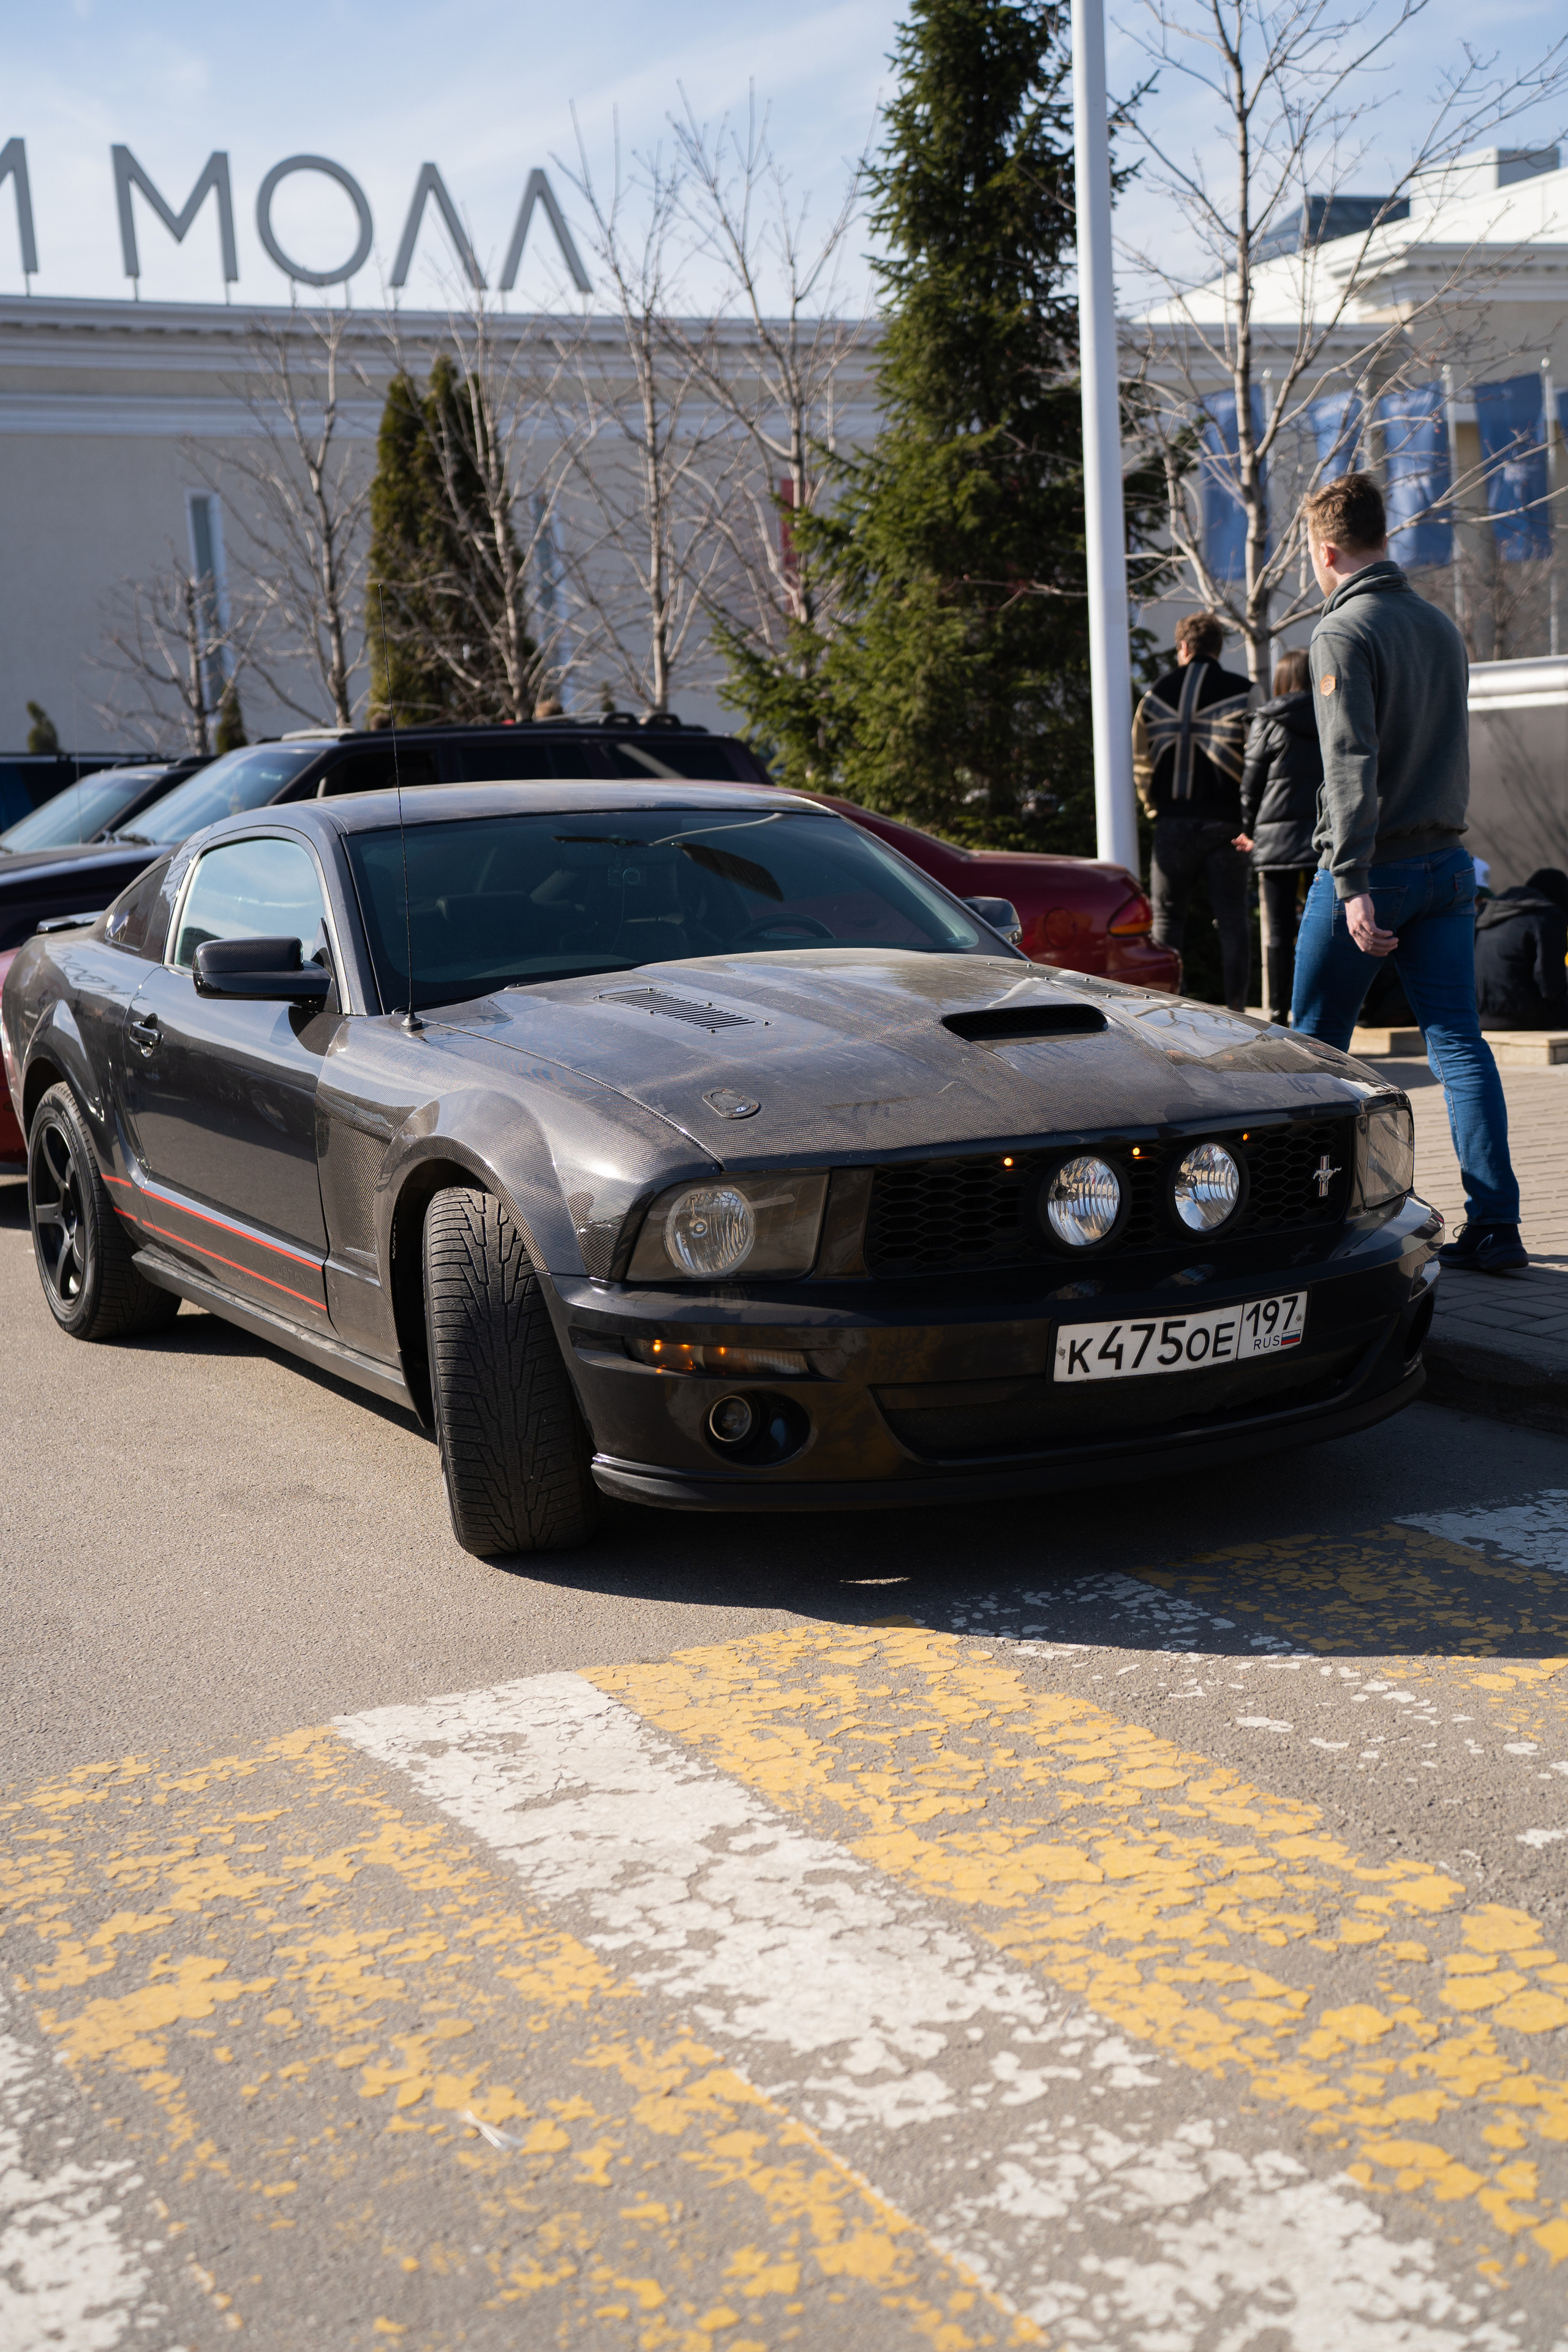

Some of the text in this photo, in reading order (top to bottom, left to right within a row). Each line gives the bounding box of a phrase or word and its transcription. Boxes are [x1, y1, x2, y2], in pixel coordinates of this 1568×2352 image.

[111, 144, 594, 293] МОЛЛ
[268, 1258, 314, 1291] MUSTANG
[1068, 1295, 1298, 1374] К475ОЕ 197
[1253, 1335, 1280, 1351] RUS
